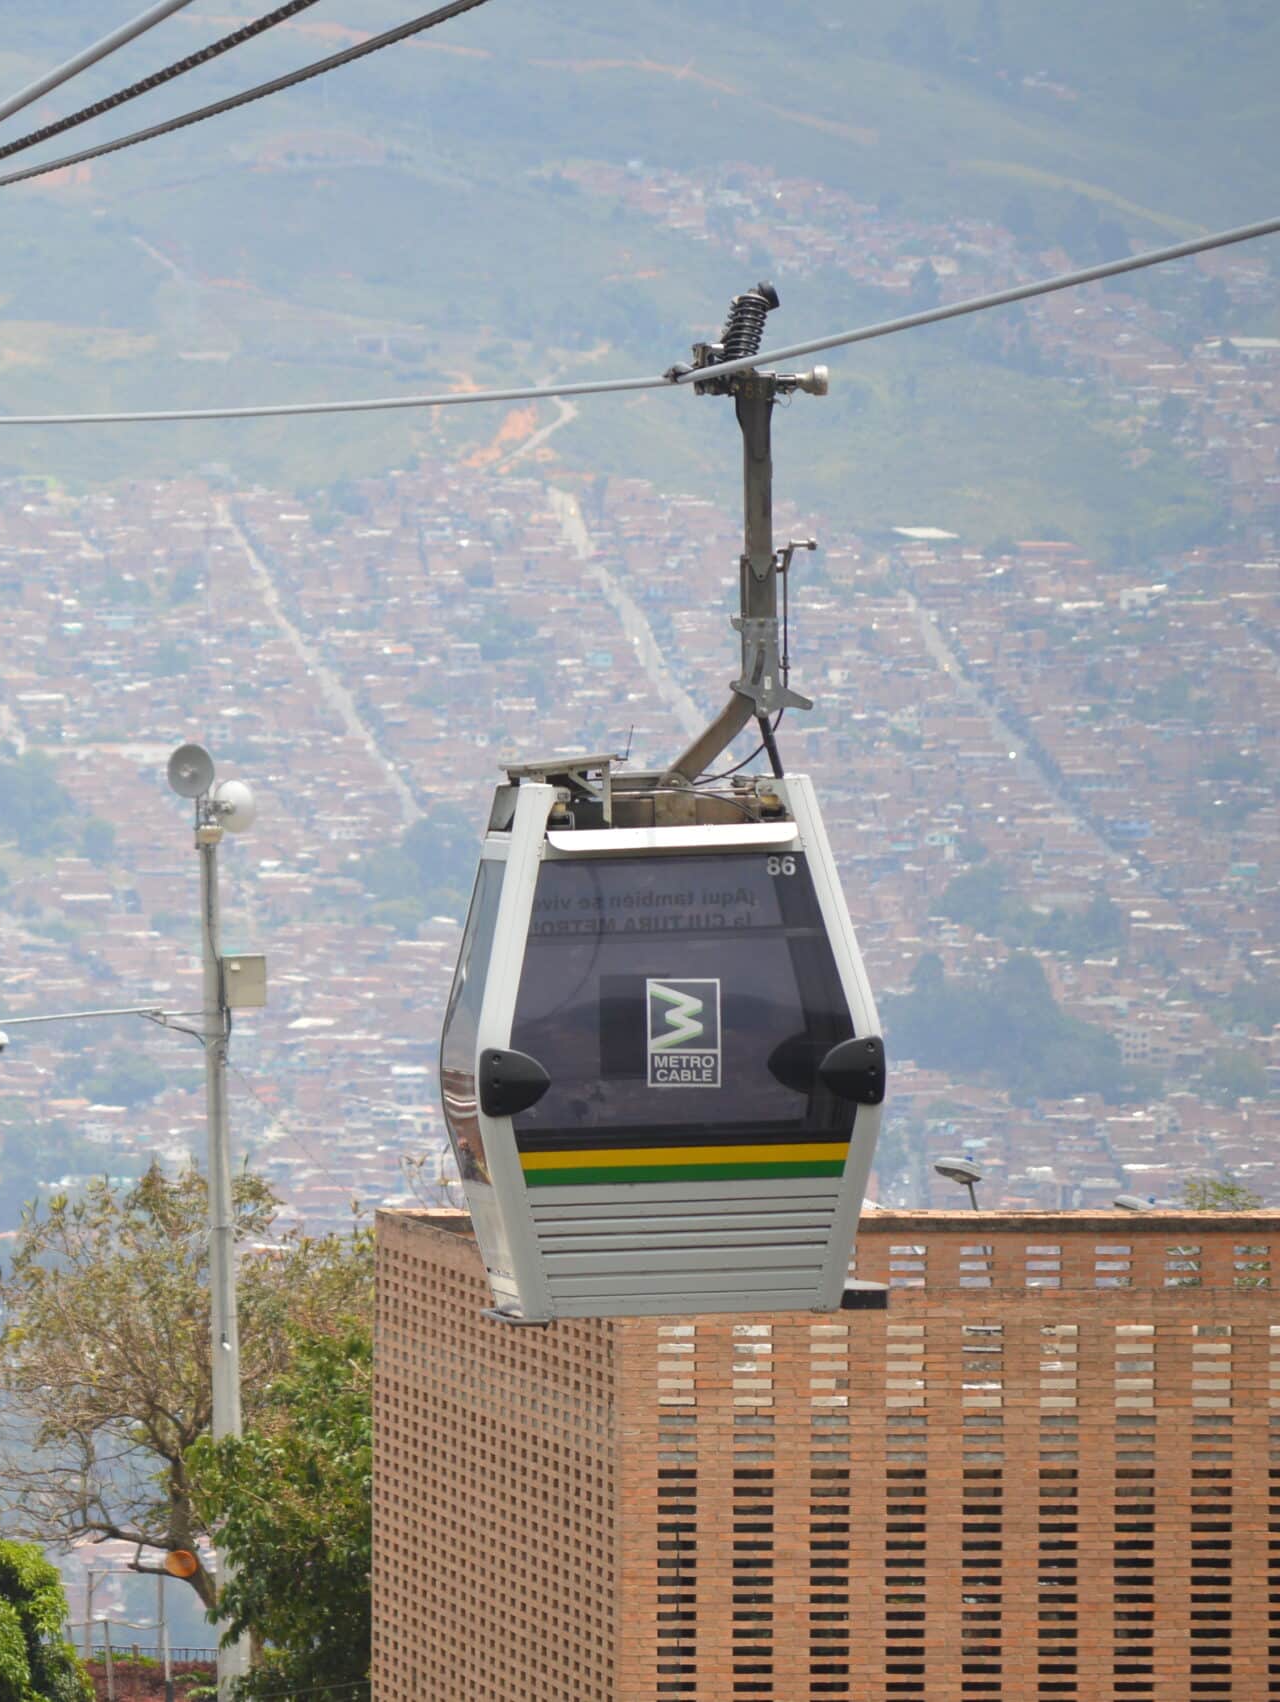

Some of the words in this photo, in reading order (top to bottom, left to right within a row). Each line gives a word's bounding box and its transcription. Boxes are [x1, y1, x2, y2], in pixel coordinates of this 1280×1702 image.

[766, 856, 797, 876] 86
[654, 1055, 715, 1069] METRO
[656, 1069, 713, 1083] CABLE
